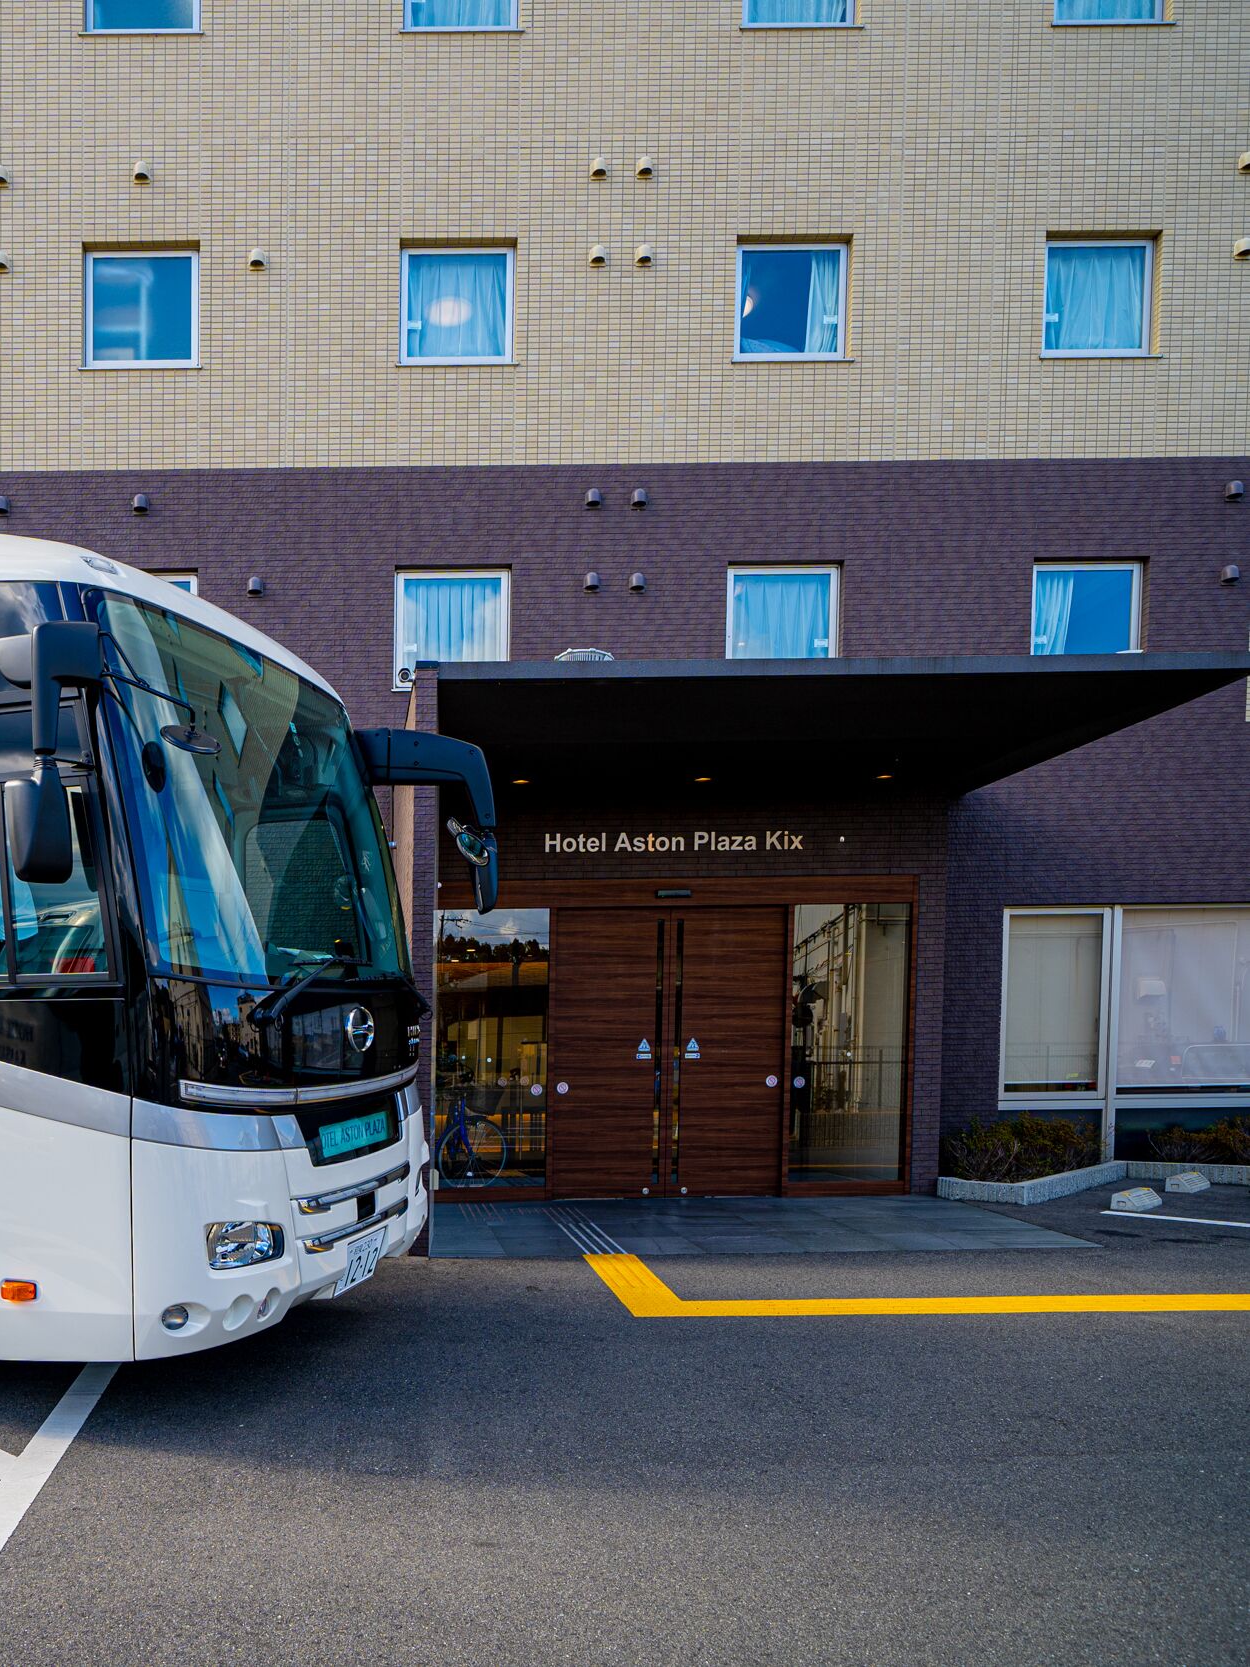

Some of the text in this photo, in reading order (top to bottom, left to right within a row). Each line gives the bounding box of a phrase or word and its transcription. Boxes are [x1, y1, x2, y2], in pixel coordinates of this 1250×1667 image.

[544, 831, 804, 853] Hotel Aston Plaza Kix
[341, 1124, 363, 1143] ASTON
[364, 1117, 385, 1137] PLAZA
